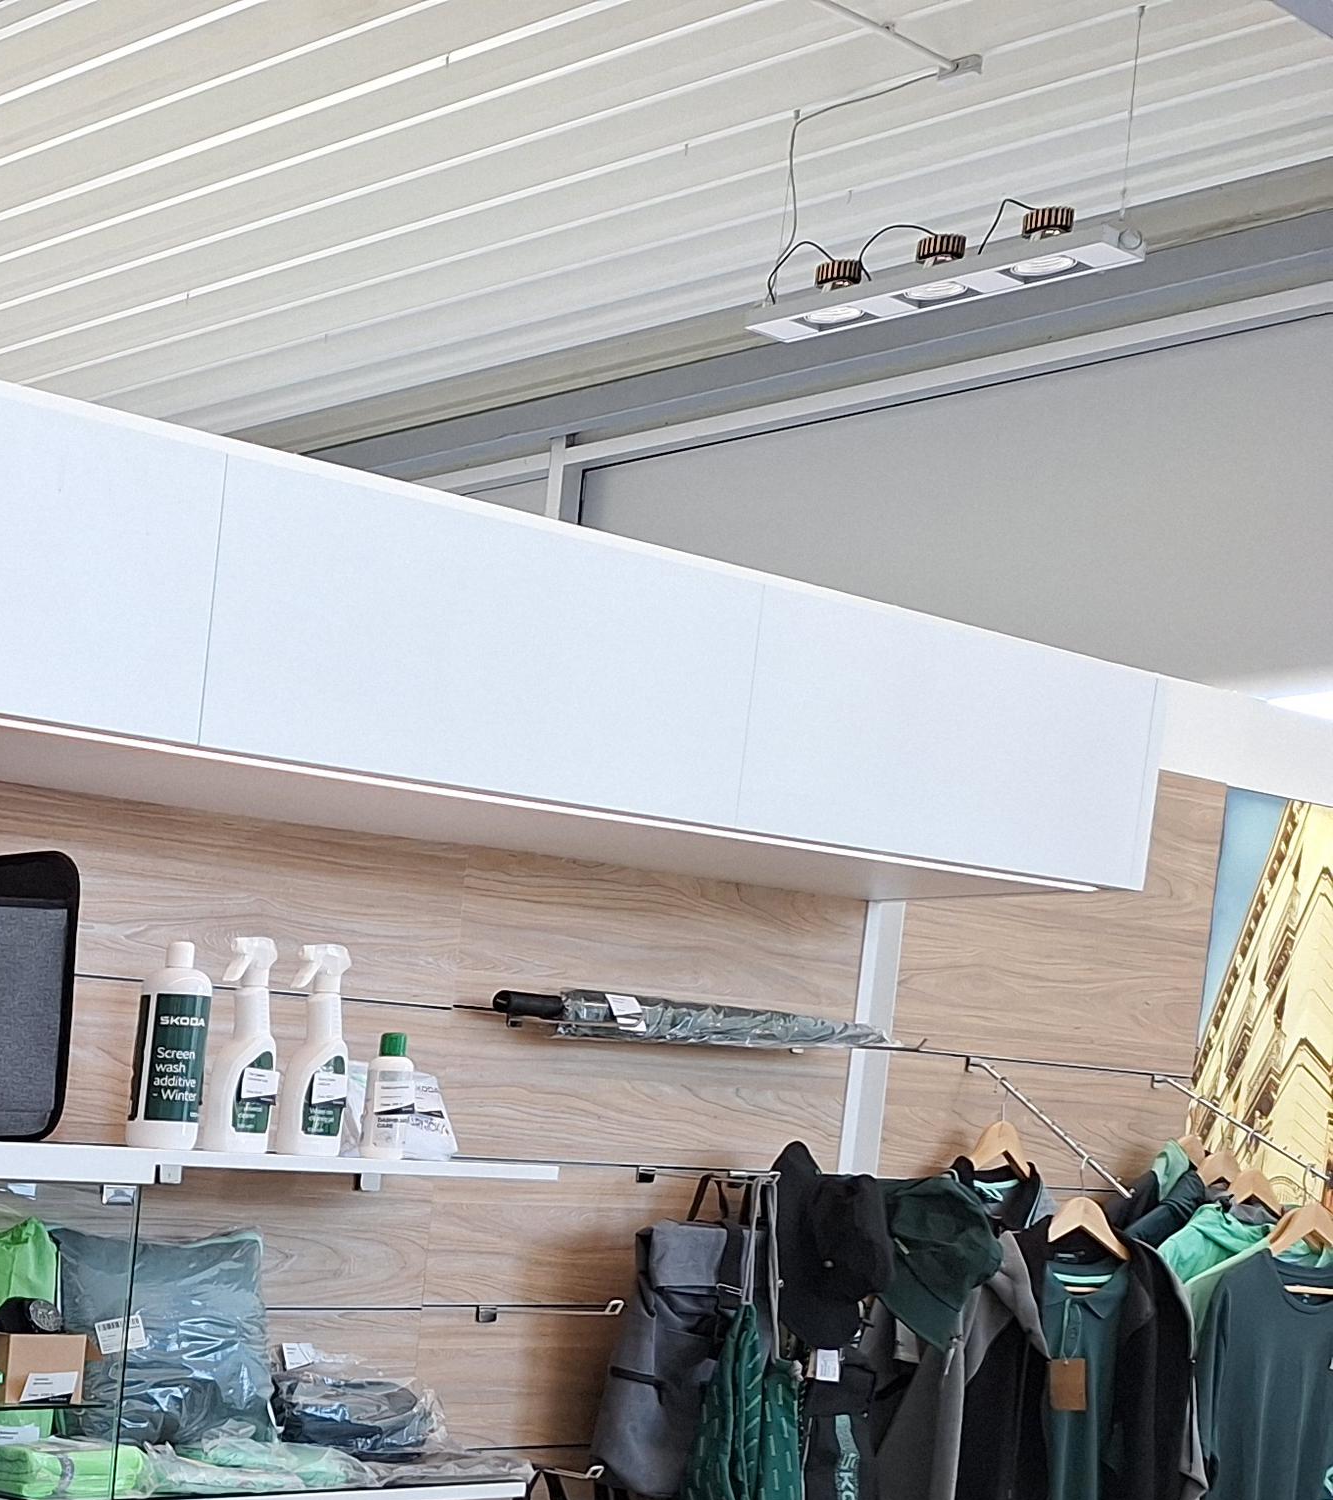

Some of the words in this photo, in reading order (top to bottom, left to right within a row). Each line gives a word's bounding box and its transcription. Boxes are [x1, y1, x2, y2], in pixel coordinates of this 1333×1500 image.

[156, 1047, 196, 1060] Screen
[155, 1061, 186, 1073] wash
[153, 1075, 197, 1088] additive
[161, 1088, 197, 1102] Winter
